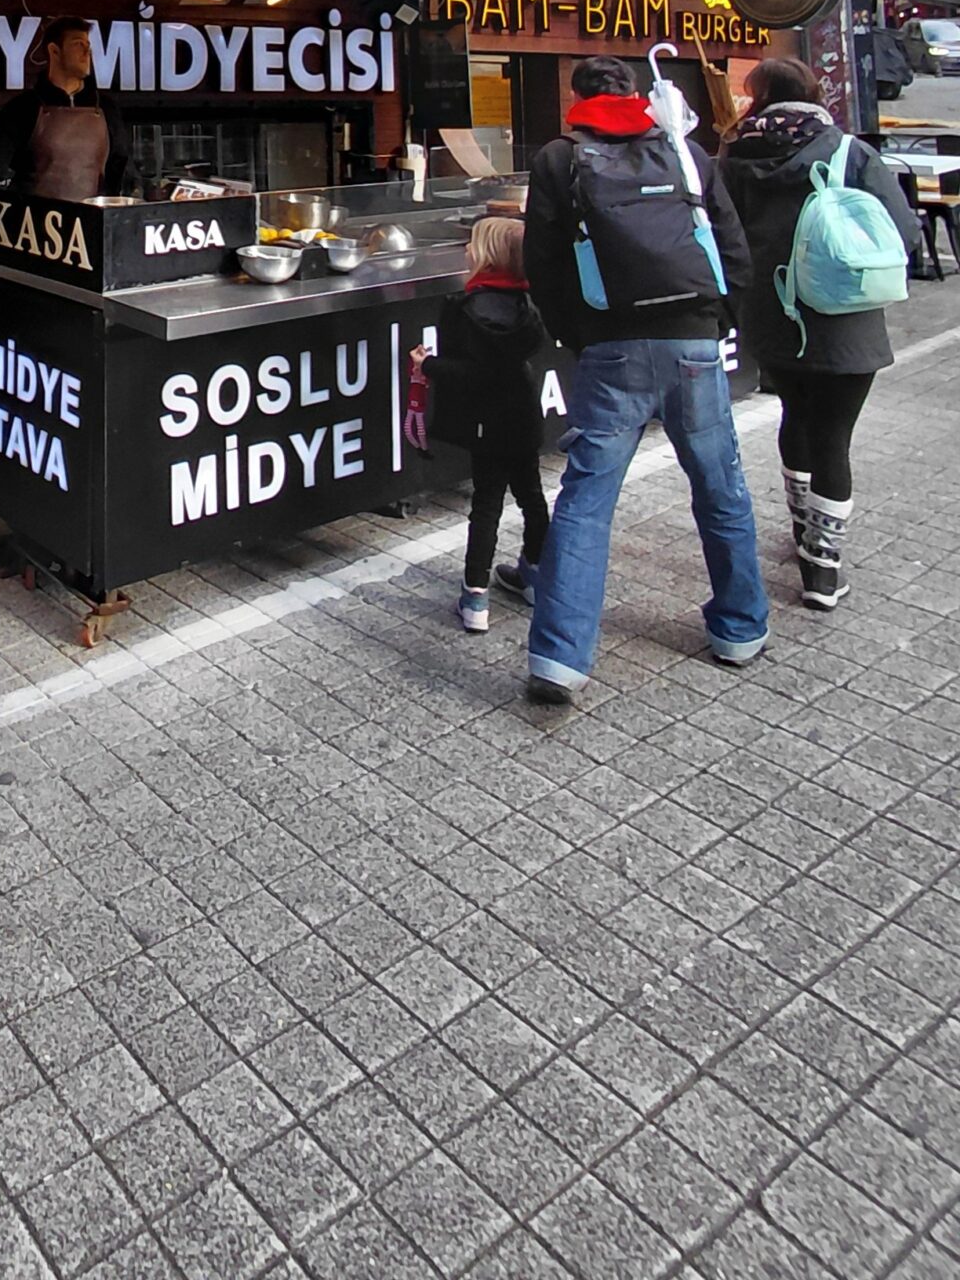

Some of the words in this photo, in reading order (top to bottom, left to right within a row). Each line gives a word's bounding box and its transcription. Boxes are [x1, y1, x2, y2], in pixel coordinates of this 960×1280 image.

[83, 0, 396, 93] MİDYECİSİ
[682, 11, 771, 46] BURGER
[144, 218, 226, 255] KASA
[159, 339, 369, 439] SOSLU
[170, 418, 366, 526] MİDYE
